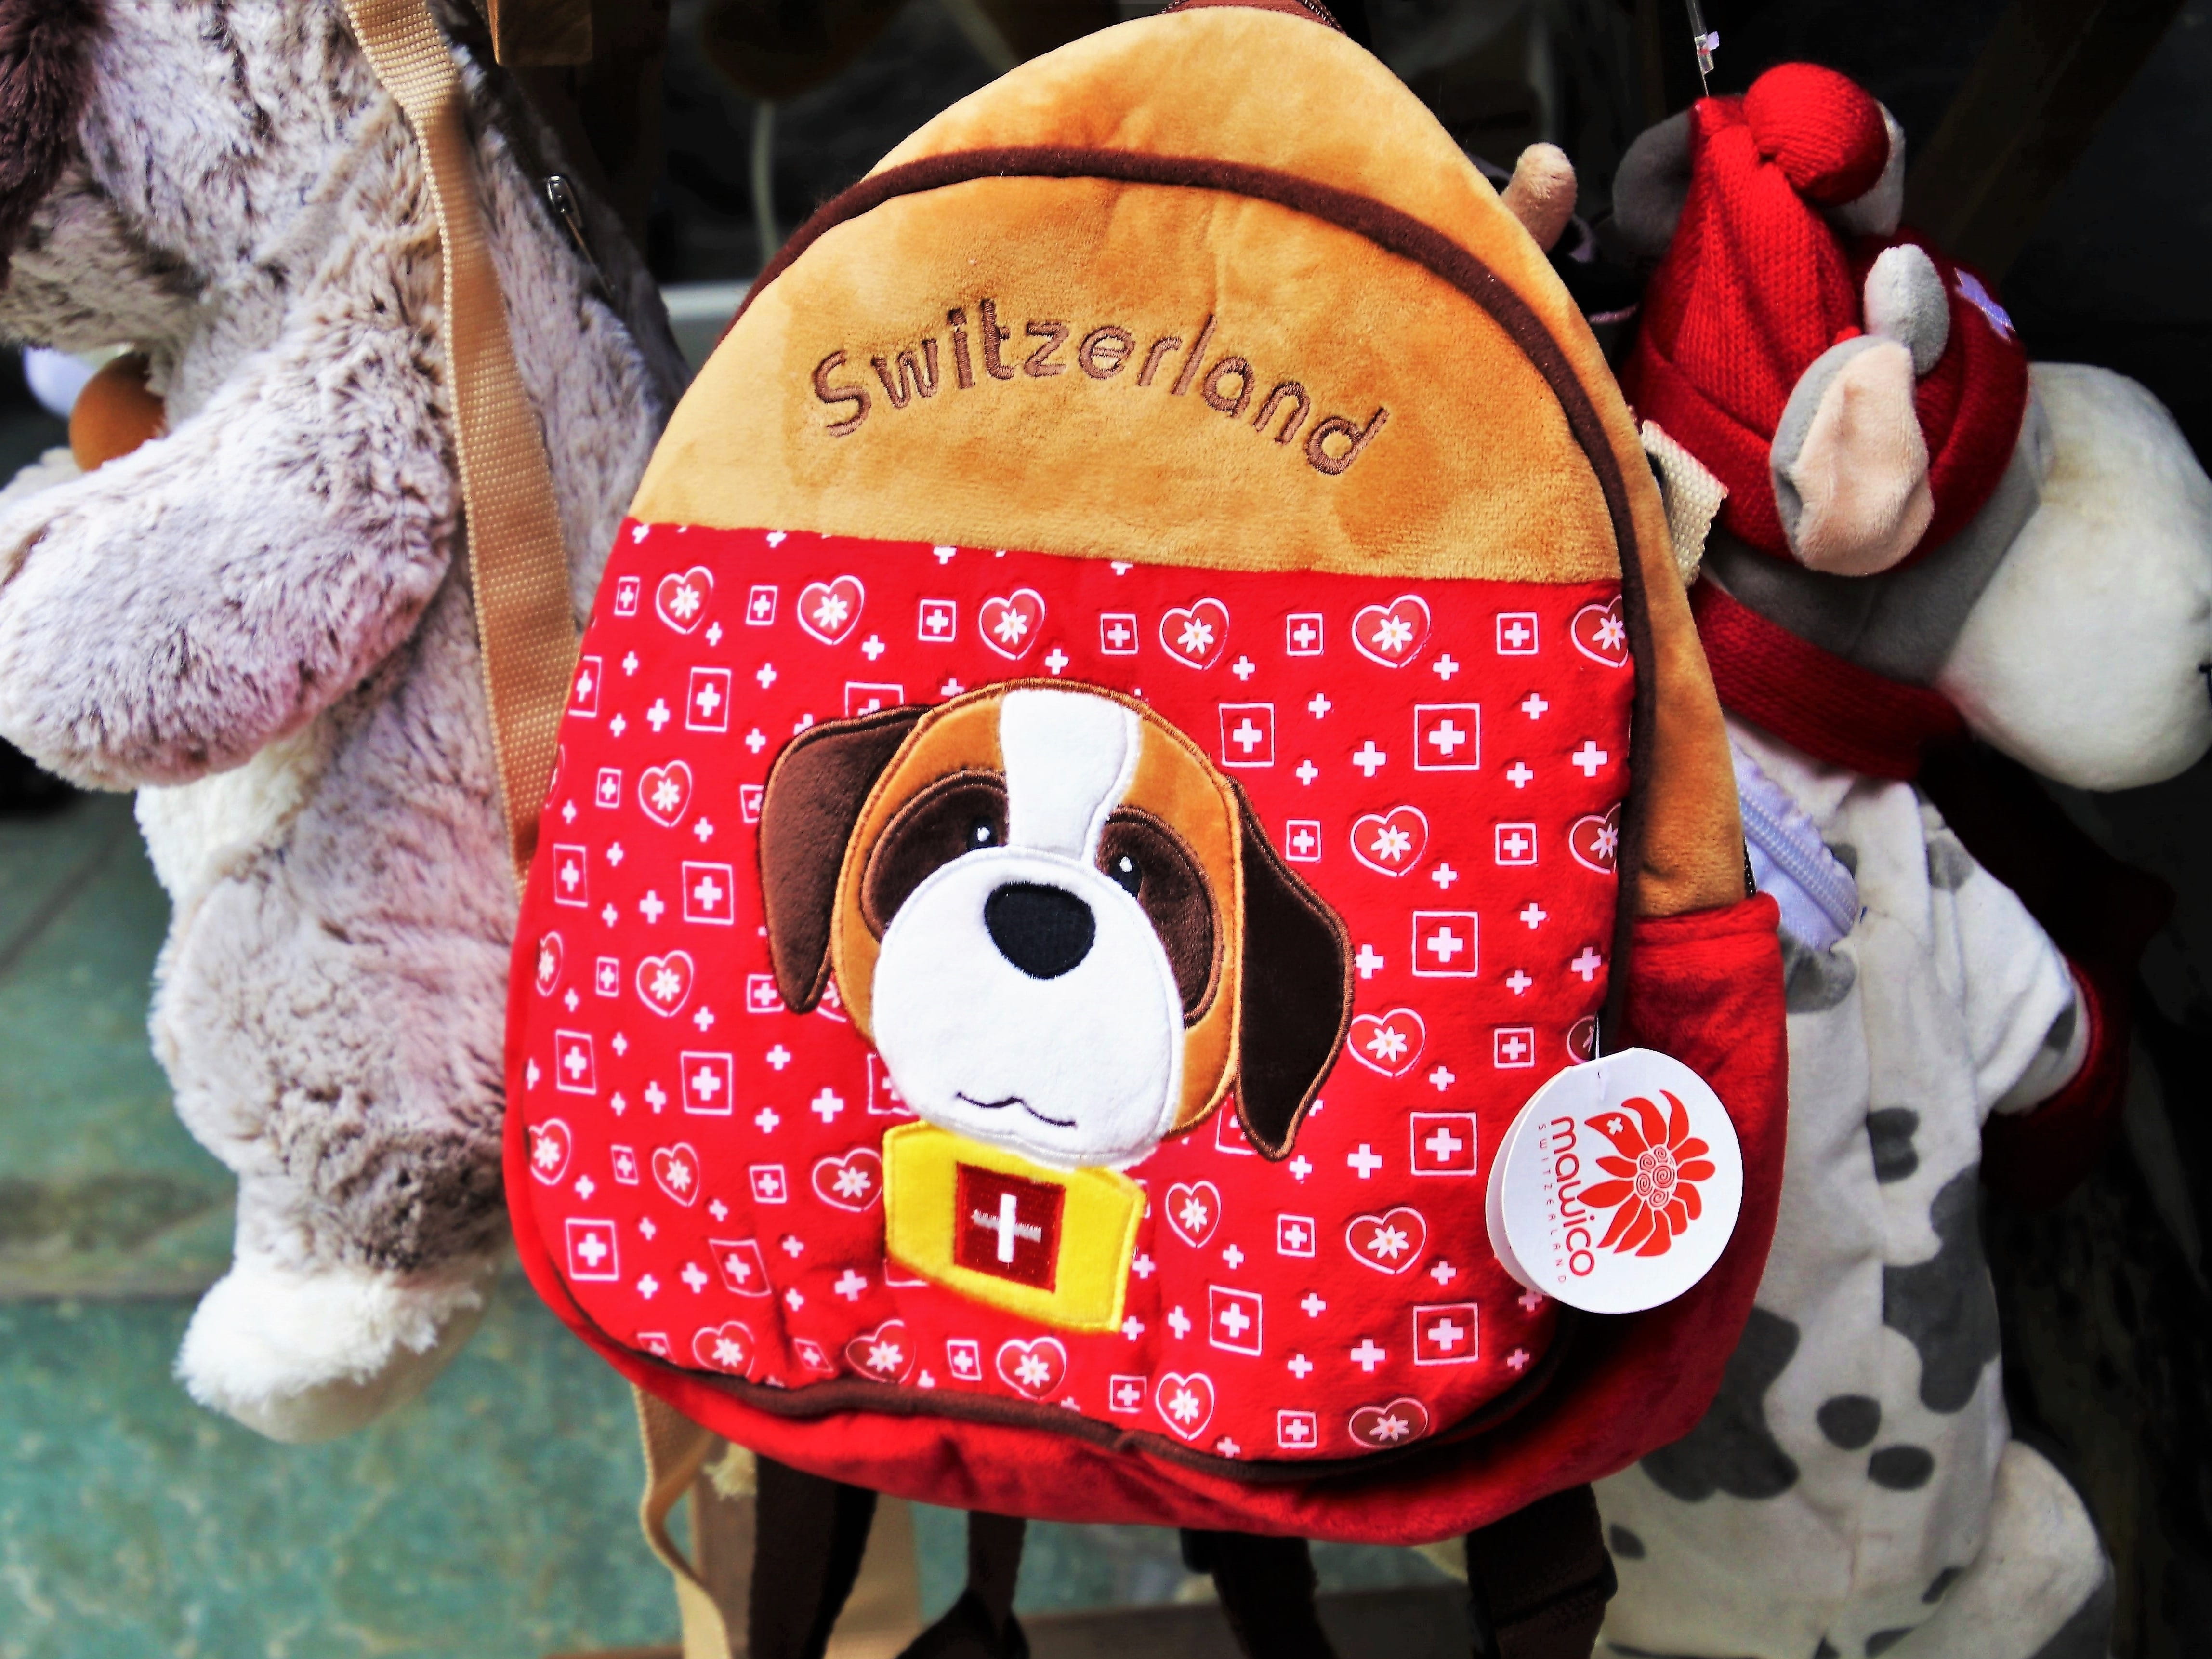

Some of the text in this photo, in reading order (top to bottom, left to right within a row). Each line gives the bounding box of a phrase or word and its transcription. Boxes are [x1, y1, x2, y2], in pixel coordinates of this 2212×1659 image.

[812, 298, 1390, 476] Switzerland
[1538, 1124, 1566, 1282] SWITZERLAND
[1551, 1115, 1595, 1276] mawico
